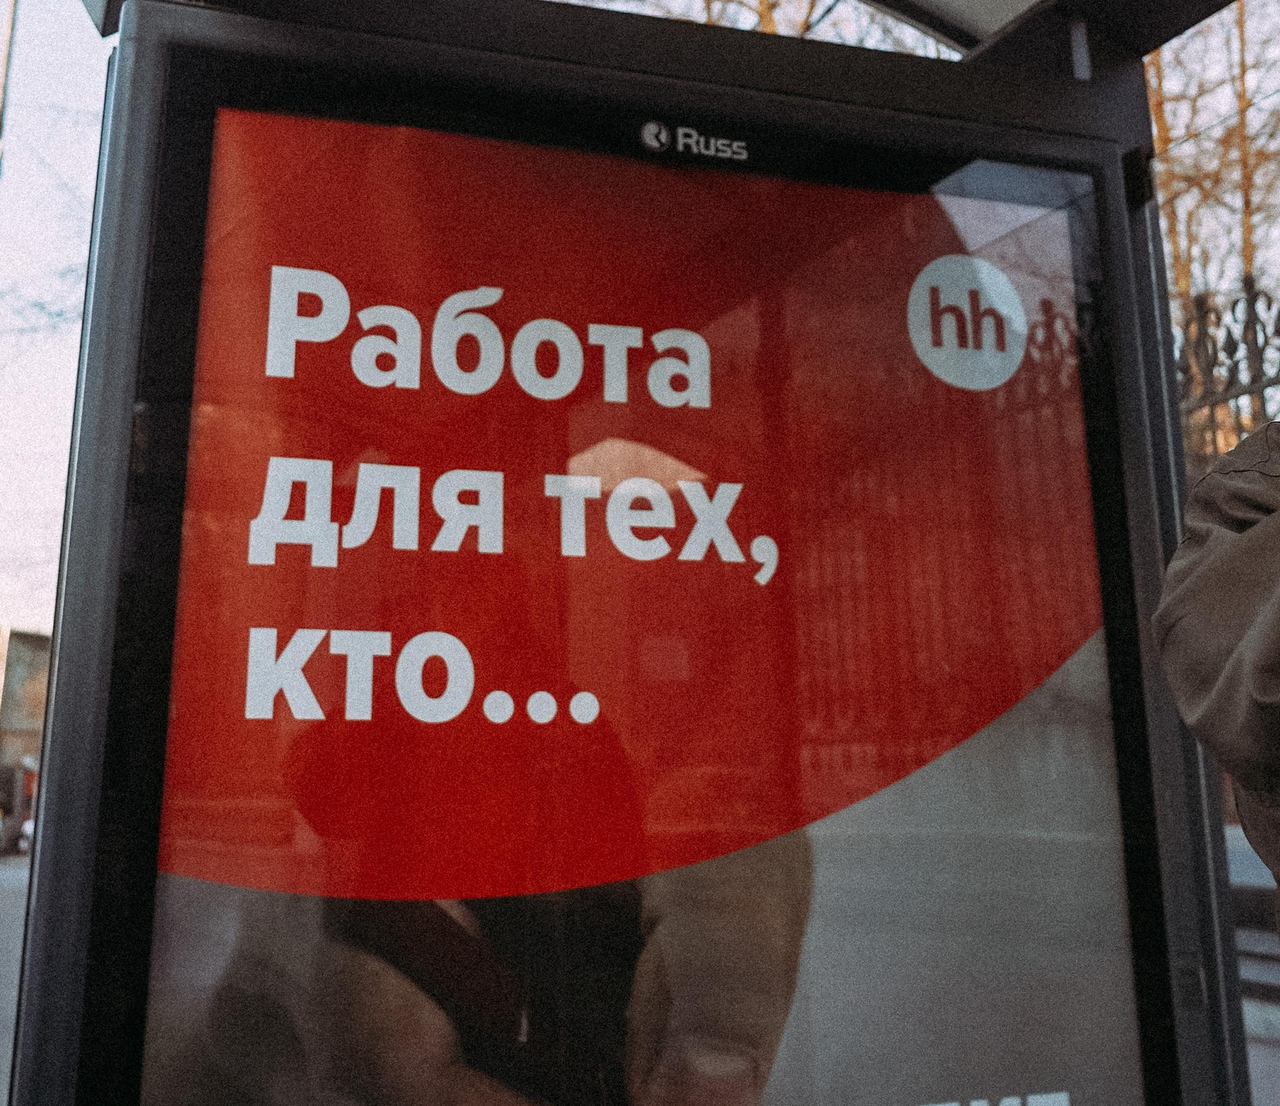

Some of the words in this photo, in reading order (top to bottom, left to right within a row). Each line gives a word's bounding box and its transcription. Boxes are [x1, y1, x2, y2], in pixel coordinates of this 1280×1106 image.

[676, 125, 749, 160] Russ
[264, 264, 712, 409] Работа
[928, 285, 1007, 354] hh
[247, 455, 505, 569] для
[544, 472, 780, 586] тех,
[244, 626, 601, 725] кто...
